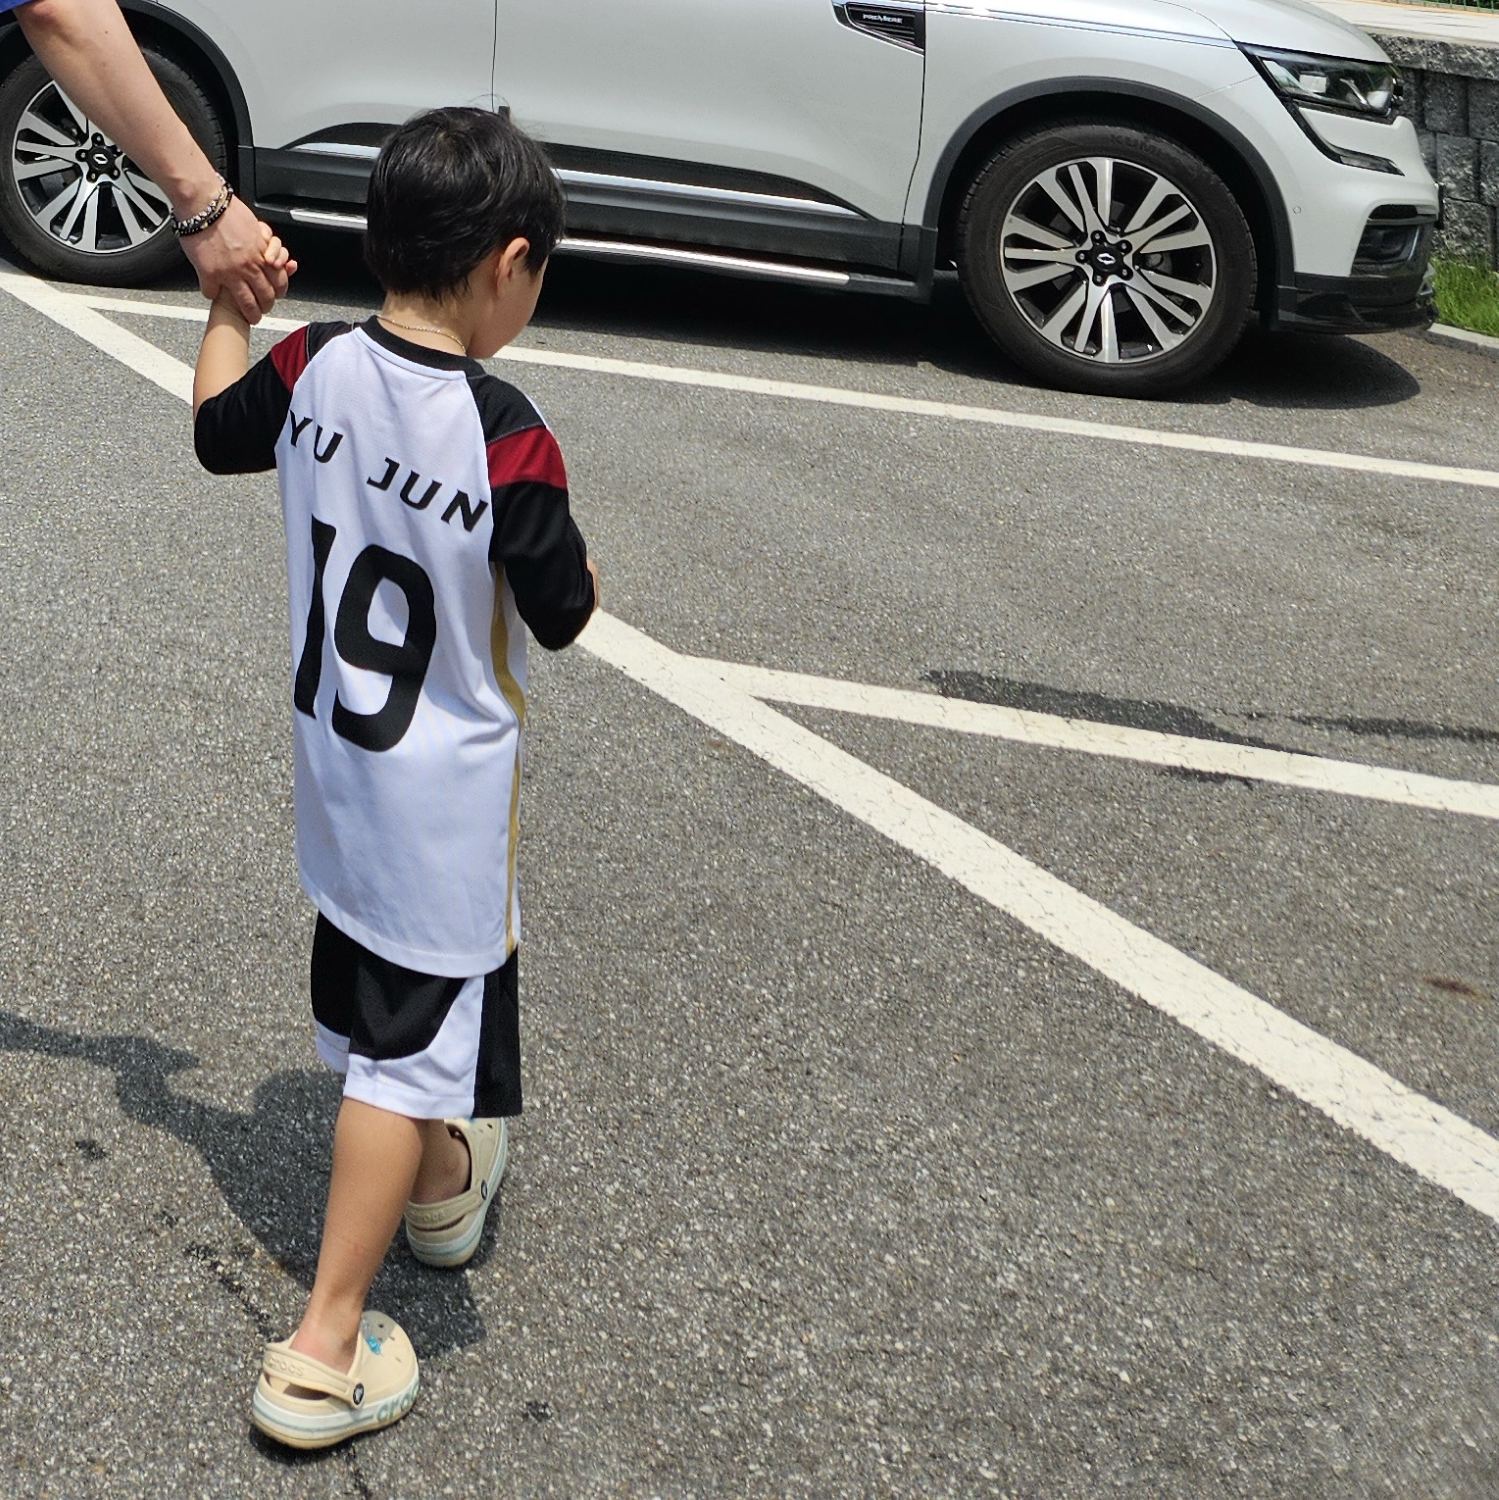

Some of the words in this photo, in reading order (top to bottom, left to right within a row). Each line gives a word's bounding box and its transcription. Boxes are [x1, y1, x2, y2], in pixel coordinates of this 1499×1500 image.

[289, 408, 344, 464] YU
[366, 456, 489, 533] JUN
[293, 513, 437, 753] 19
